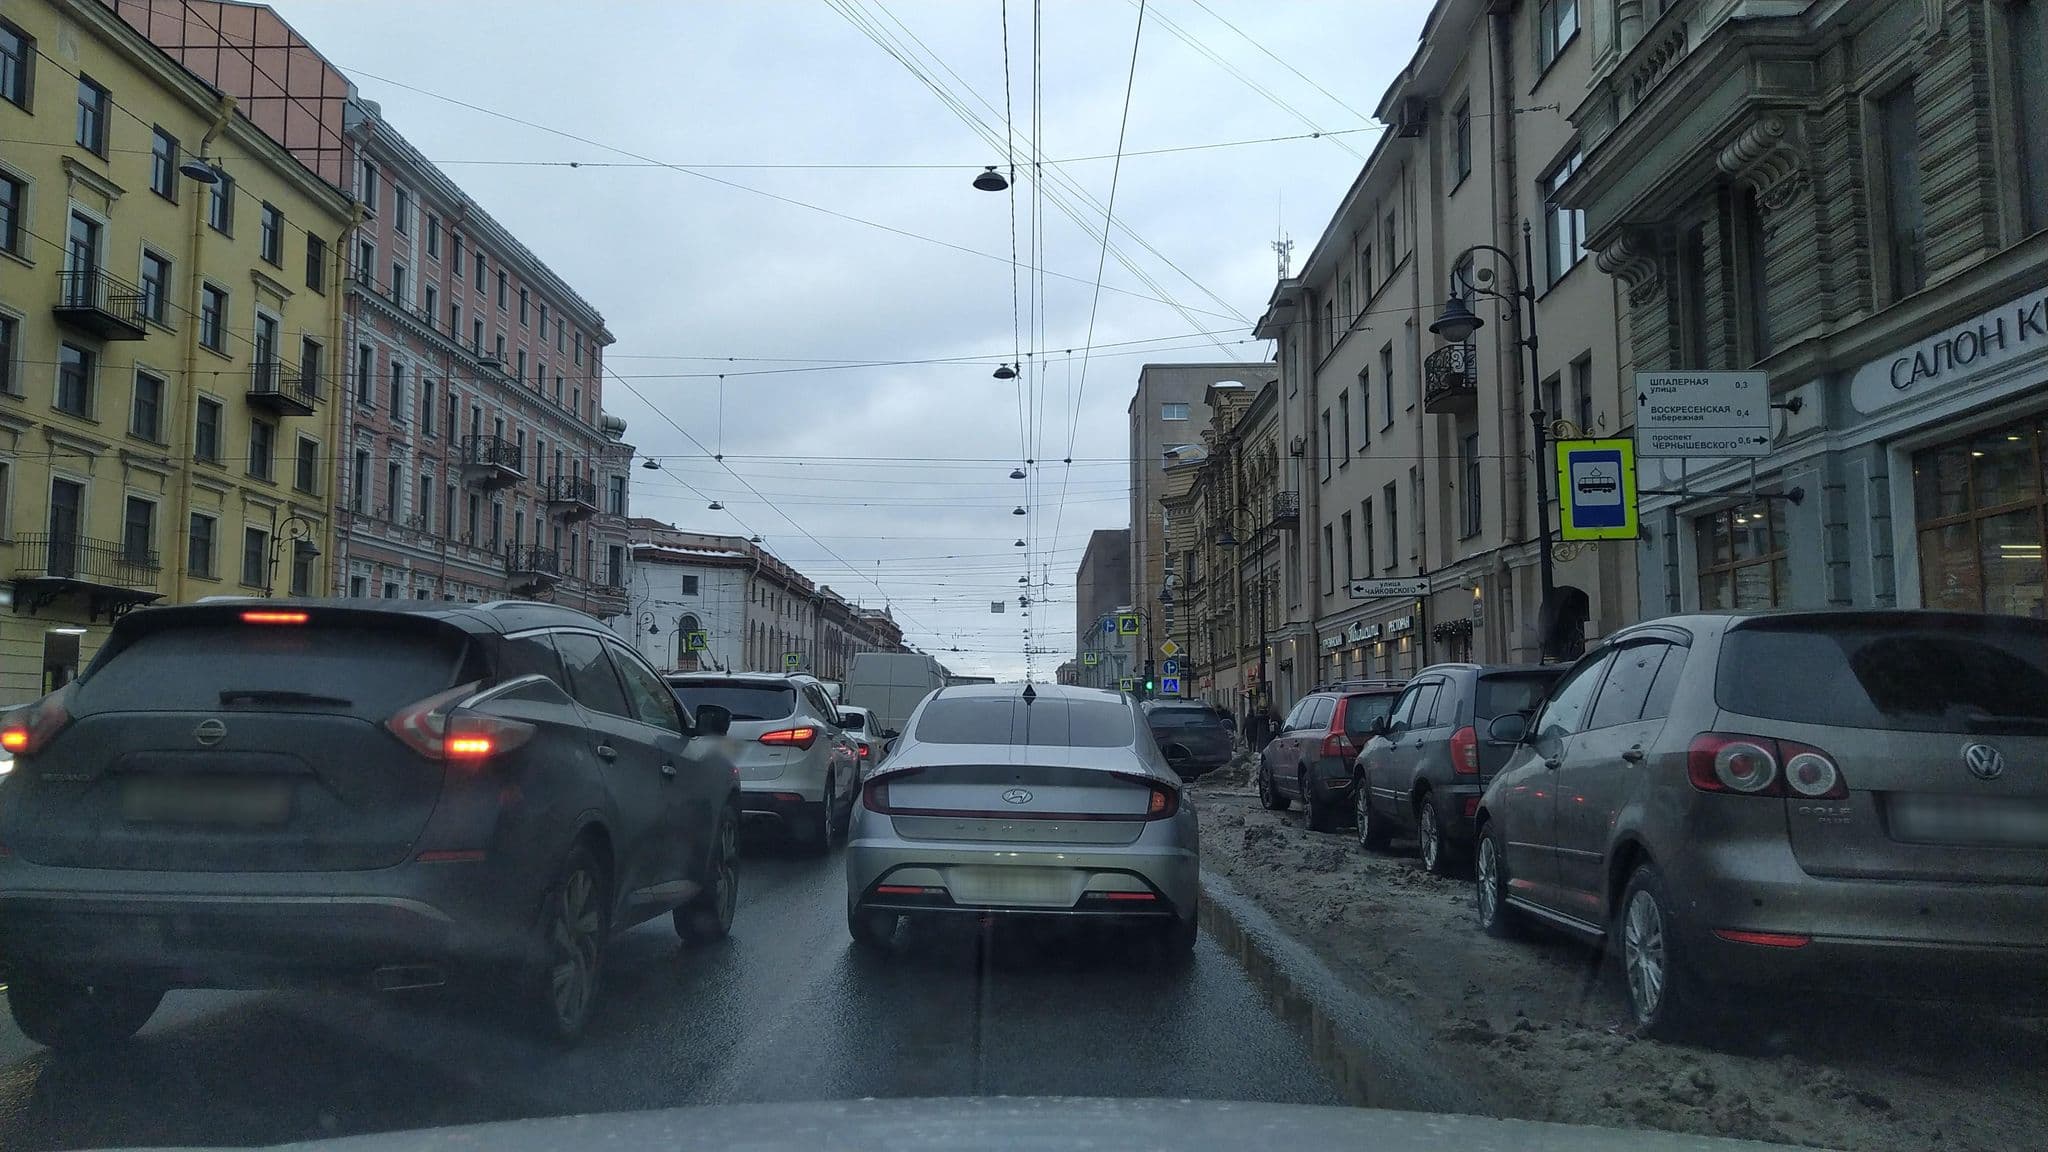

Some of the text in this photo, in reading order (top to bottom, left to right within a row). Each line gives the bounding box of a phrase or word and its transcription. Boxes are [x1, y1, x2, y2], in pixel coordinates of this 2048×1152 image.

[1889, 297, 2048, 391] САЛОН К
[1650, 378, 1748, 390] ШПАЛЕРНАЯ 0,3
[1650, 386, 1677, 394] улица
[1651, 405, 1750, 418] ВОСКРЕСЕНСКАЯ 0,4
[1651, 414, 1704, 423] набережная
[1652, 434, 1692, 442] проспект
[1652, 441, 1737, 450] ЧЕРНЫШЕВСКОГО
[1365, 587, 1416, 595] ЧАЙКОВСКОГО
